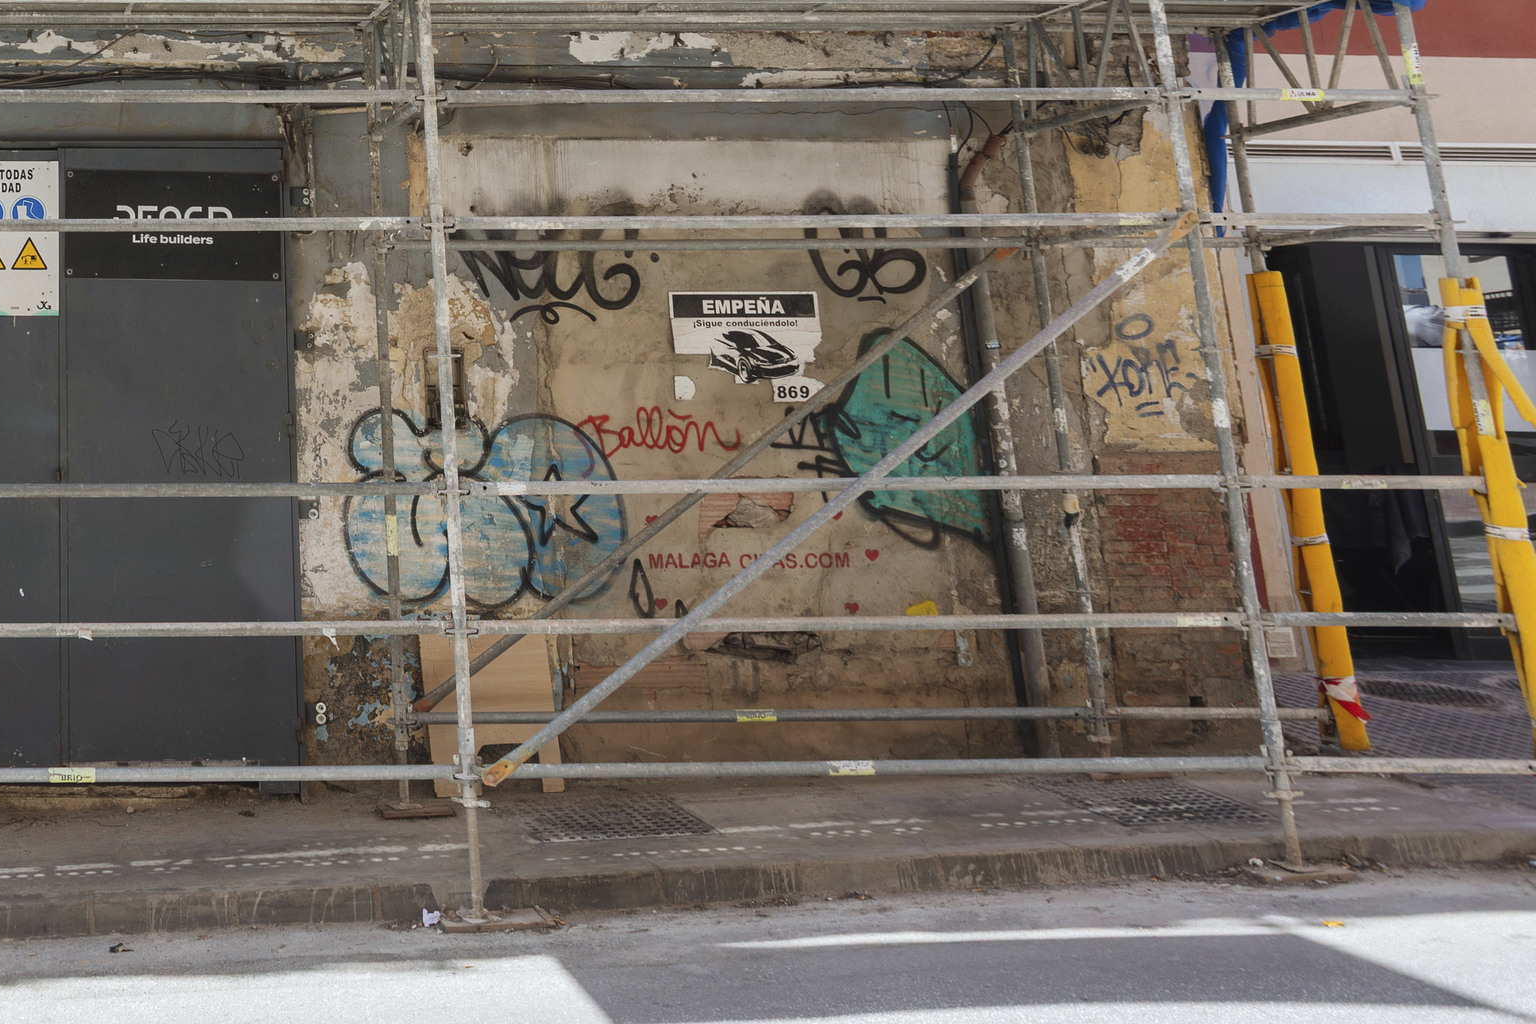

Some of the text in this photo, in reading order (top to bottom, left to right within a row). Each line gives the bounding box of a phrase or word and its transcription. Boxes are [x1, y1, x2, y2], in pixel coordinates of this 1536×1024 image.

[0, 169, 34, 180] TODAS
[132, 233, 214, 245] Life builders
[702, 296, 786, 315] EMPEÑA
[693, 318, 798, 329] ¡Sigue conduciéndolo!
[777, 385, 810, 399] 869
[648, 552, 851, 569] MALAGA CAS.COM
